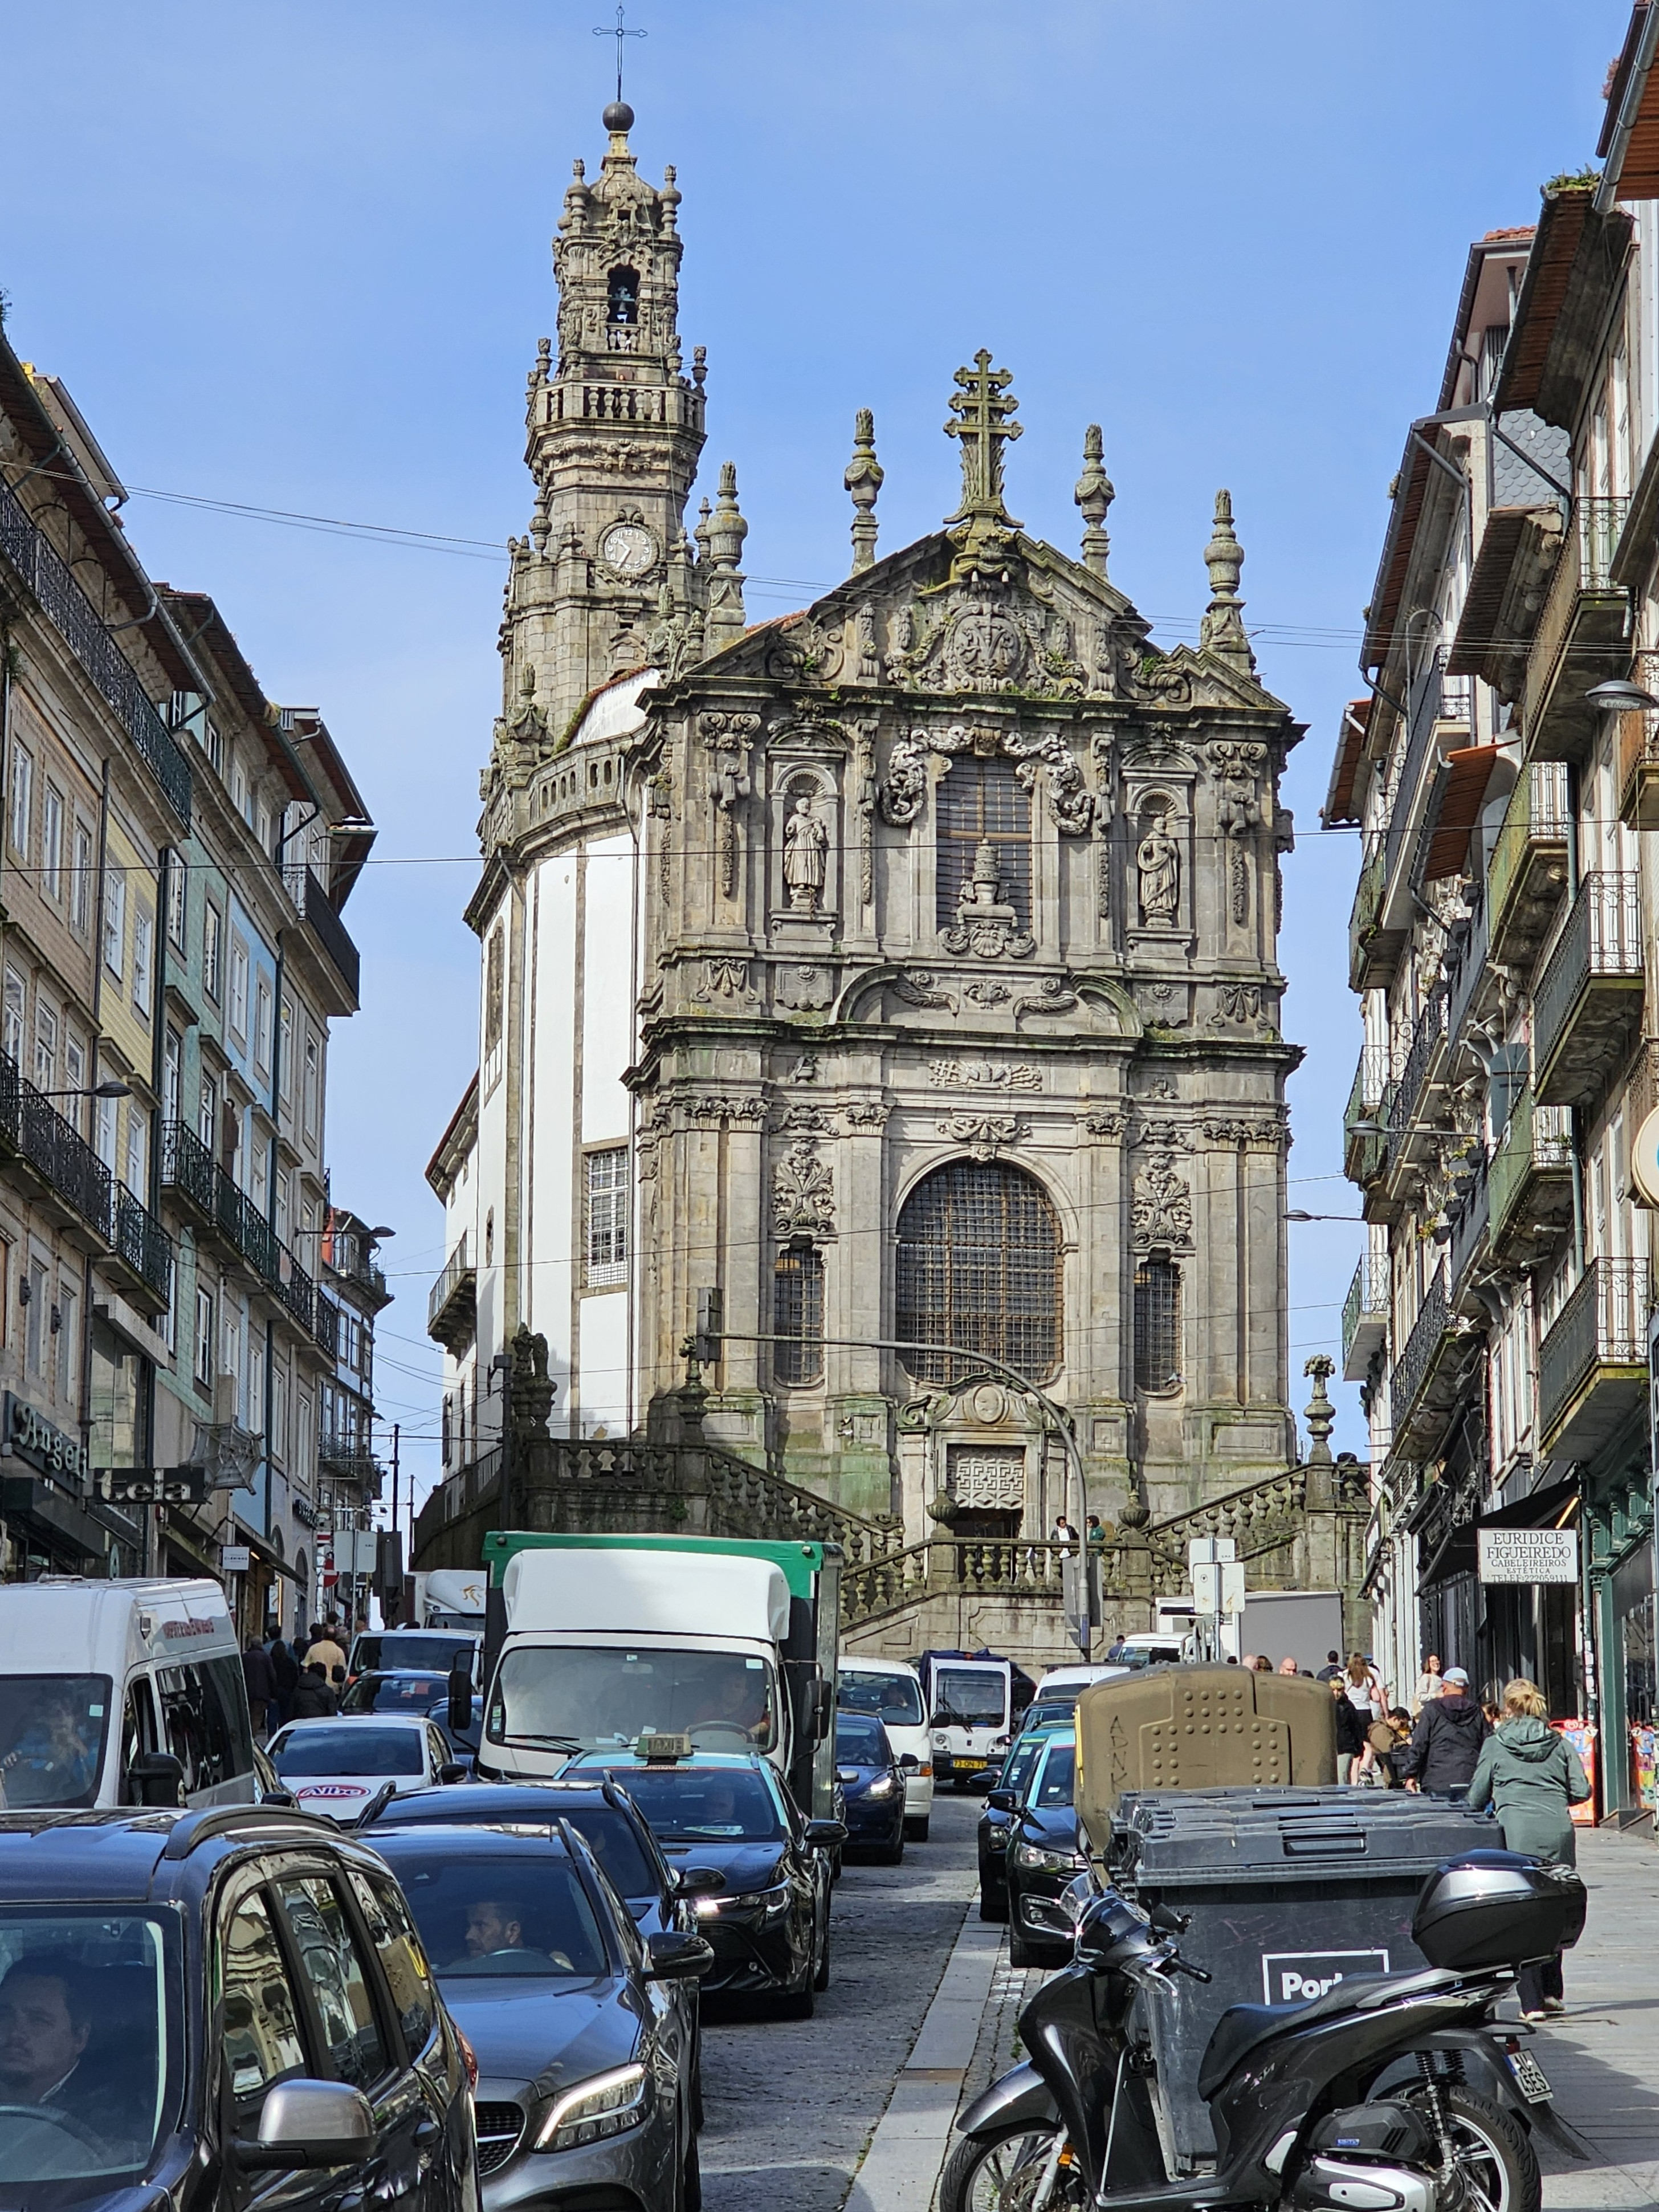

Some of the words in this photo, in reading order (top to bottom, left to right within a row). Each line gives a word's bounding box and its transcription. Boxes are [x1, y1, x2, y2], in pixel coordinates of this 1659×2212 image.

[93, 1469, 191, 1501] tela
[1493, 1533, 1564, 1545] EURIDICE
[1487, 1546, 1571, 1559] FIGUEIREDO
[1491, 1559, 1567, 1567] CABELEIREIROS
